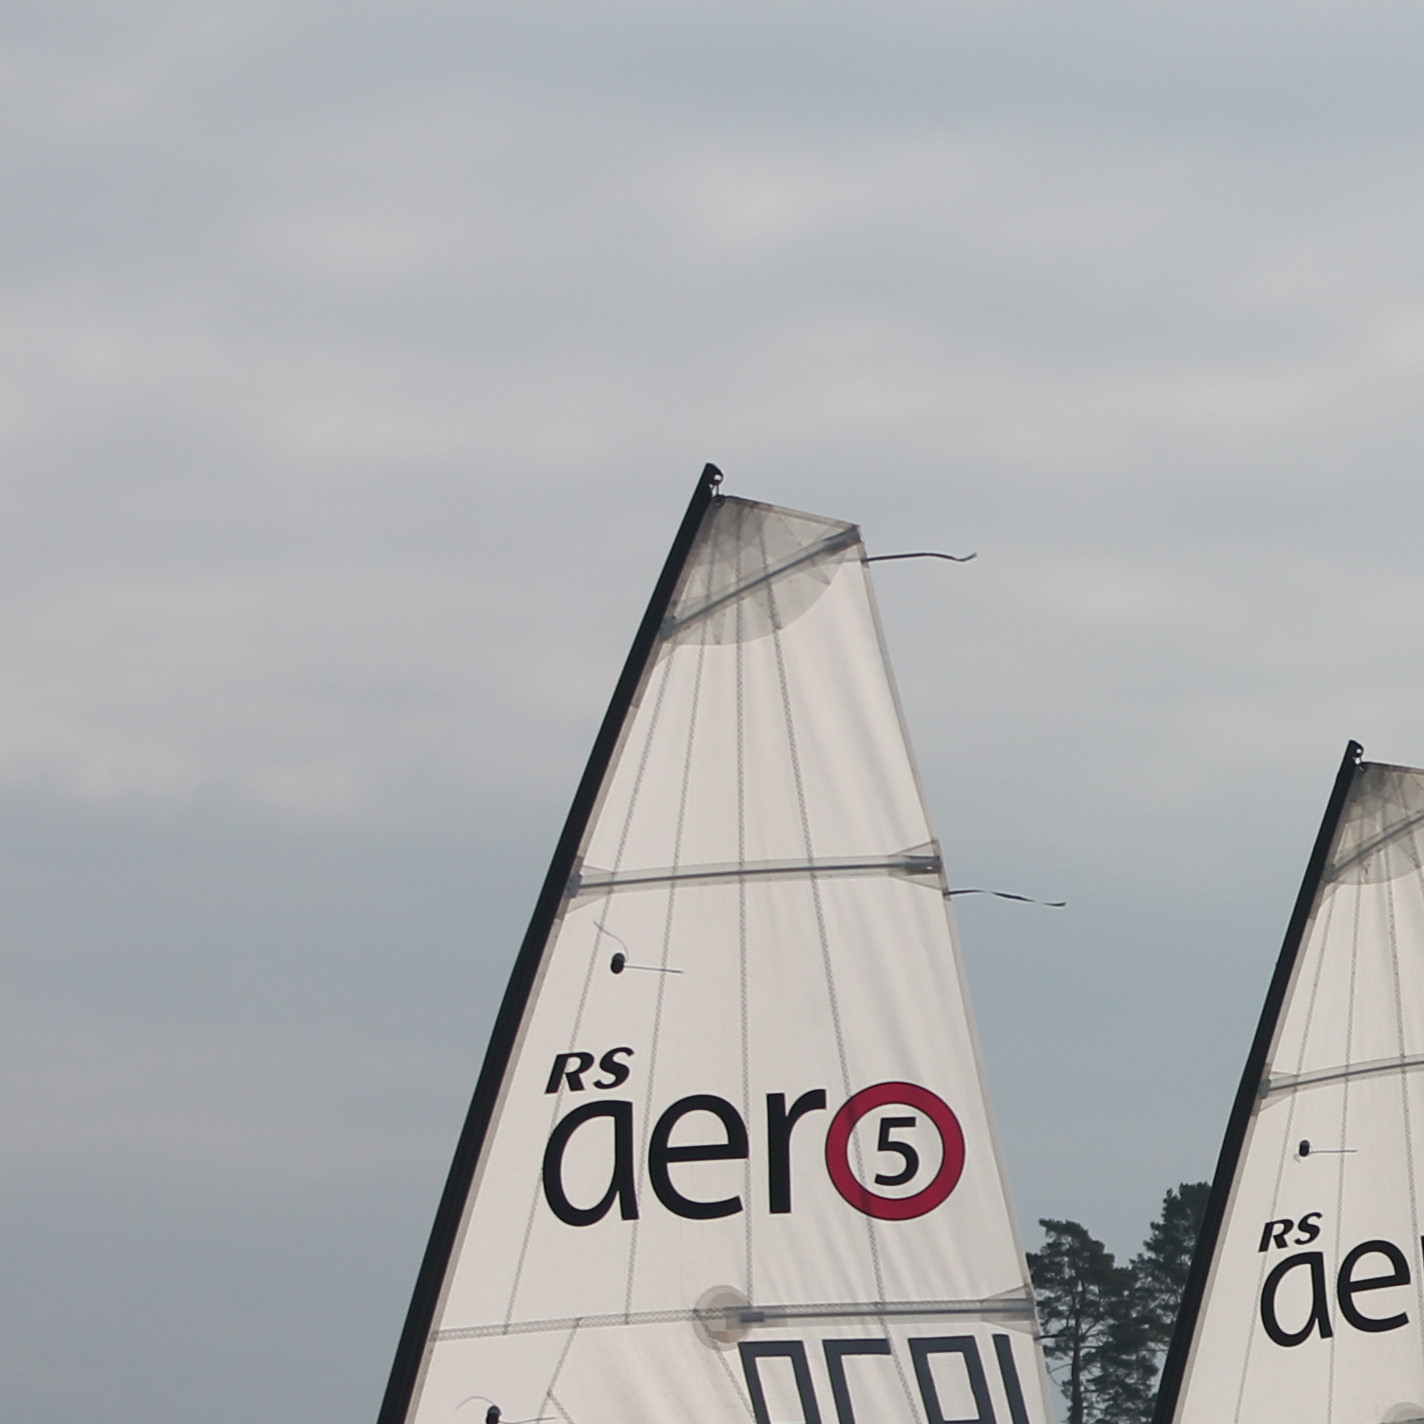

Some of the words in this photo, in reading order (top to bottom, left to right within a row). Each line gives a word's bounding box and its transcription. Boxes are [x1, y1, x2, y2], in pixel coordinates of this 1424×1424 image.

[544, 1046, 635, 1094] RS
[874, 1116, 920, 1186] 5
[1258, 1212, 1323, 1252] RS
